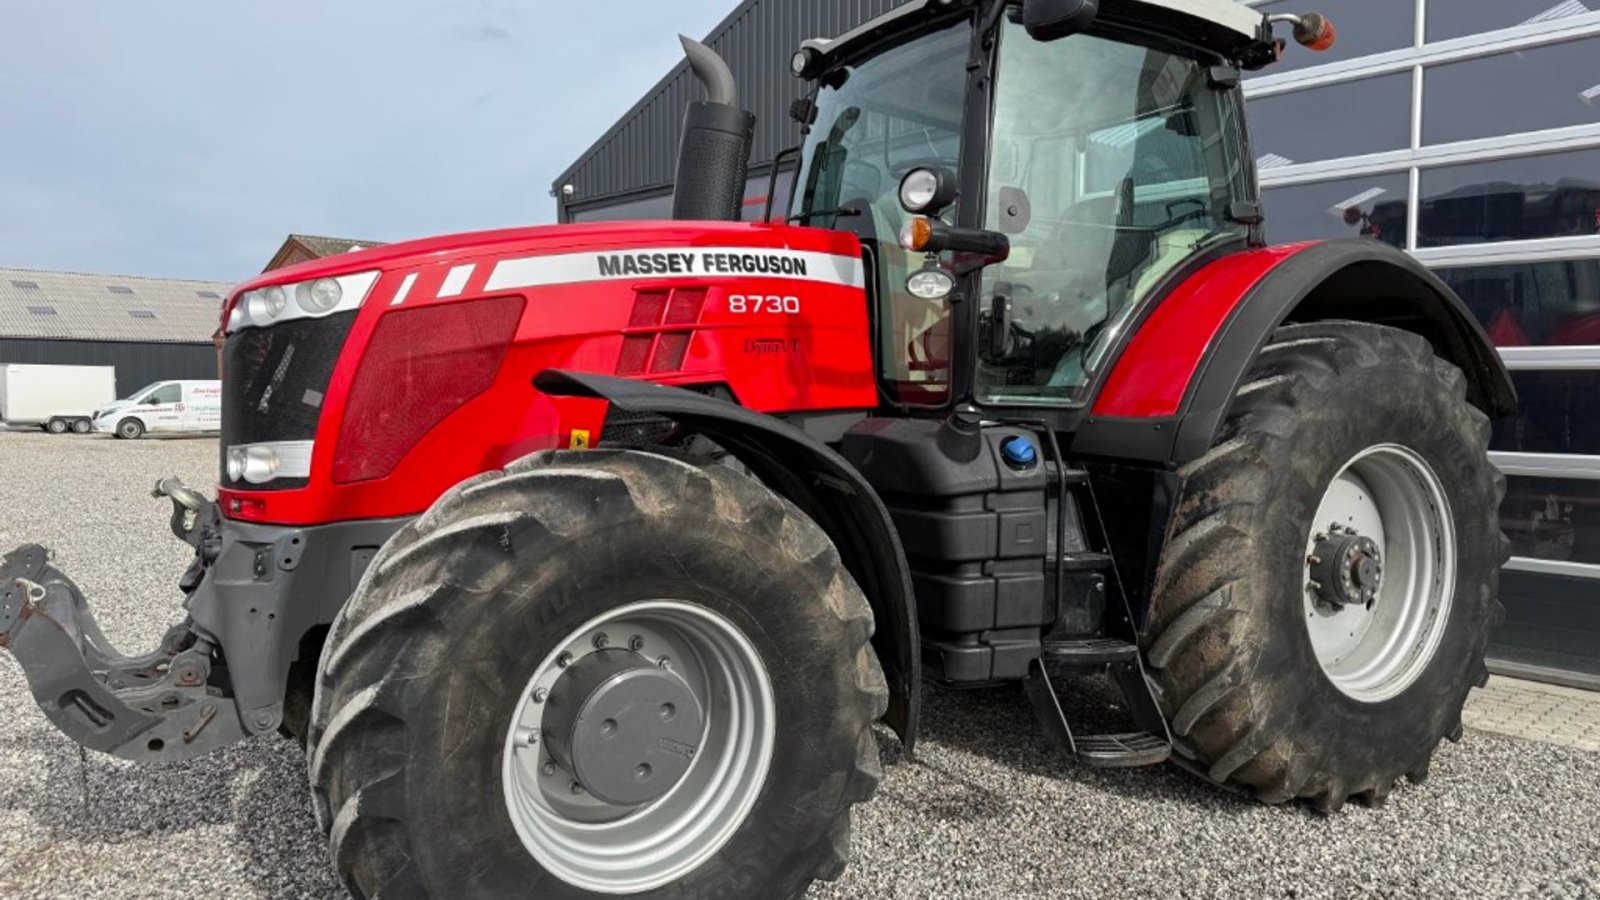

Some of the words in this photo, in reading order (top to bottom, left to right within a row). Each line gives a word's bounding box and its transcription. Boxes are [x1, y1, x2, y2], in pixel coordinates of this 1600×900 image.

[597, 253, 695, 276] MASSEY
[702, 253, 807, 276] FERGUSON
[728, 294, 800, 314] 8730
